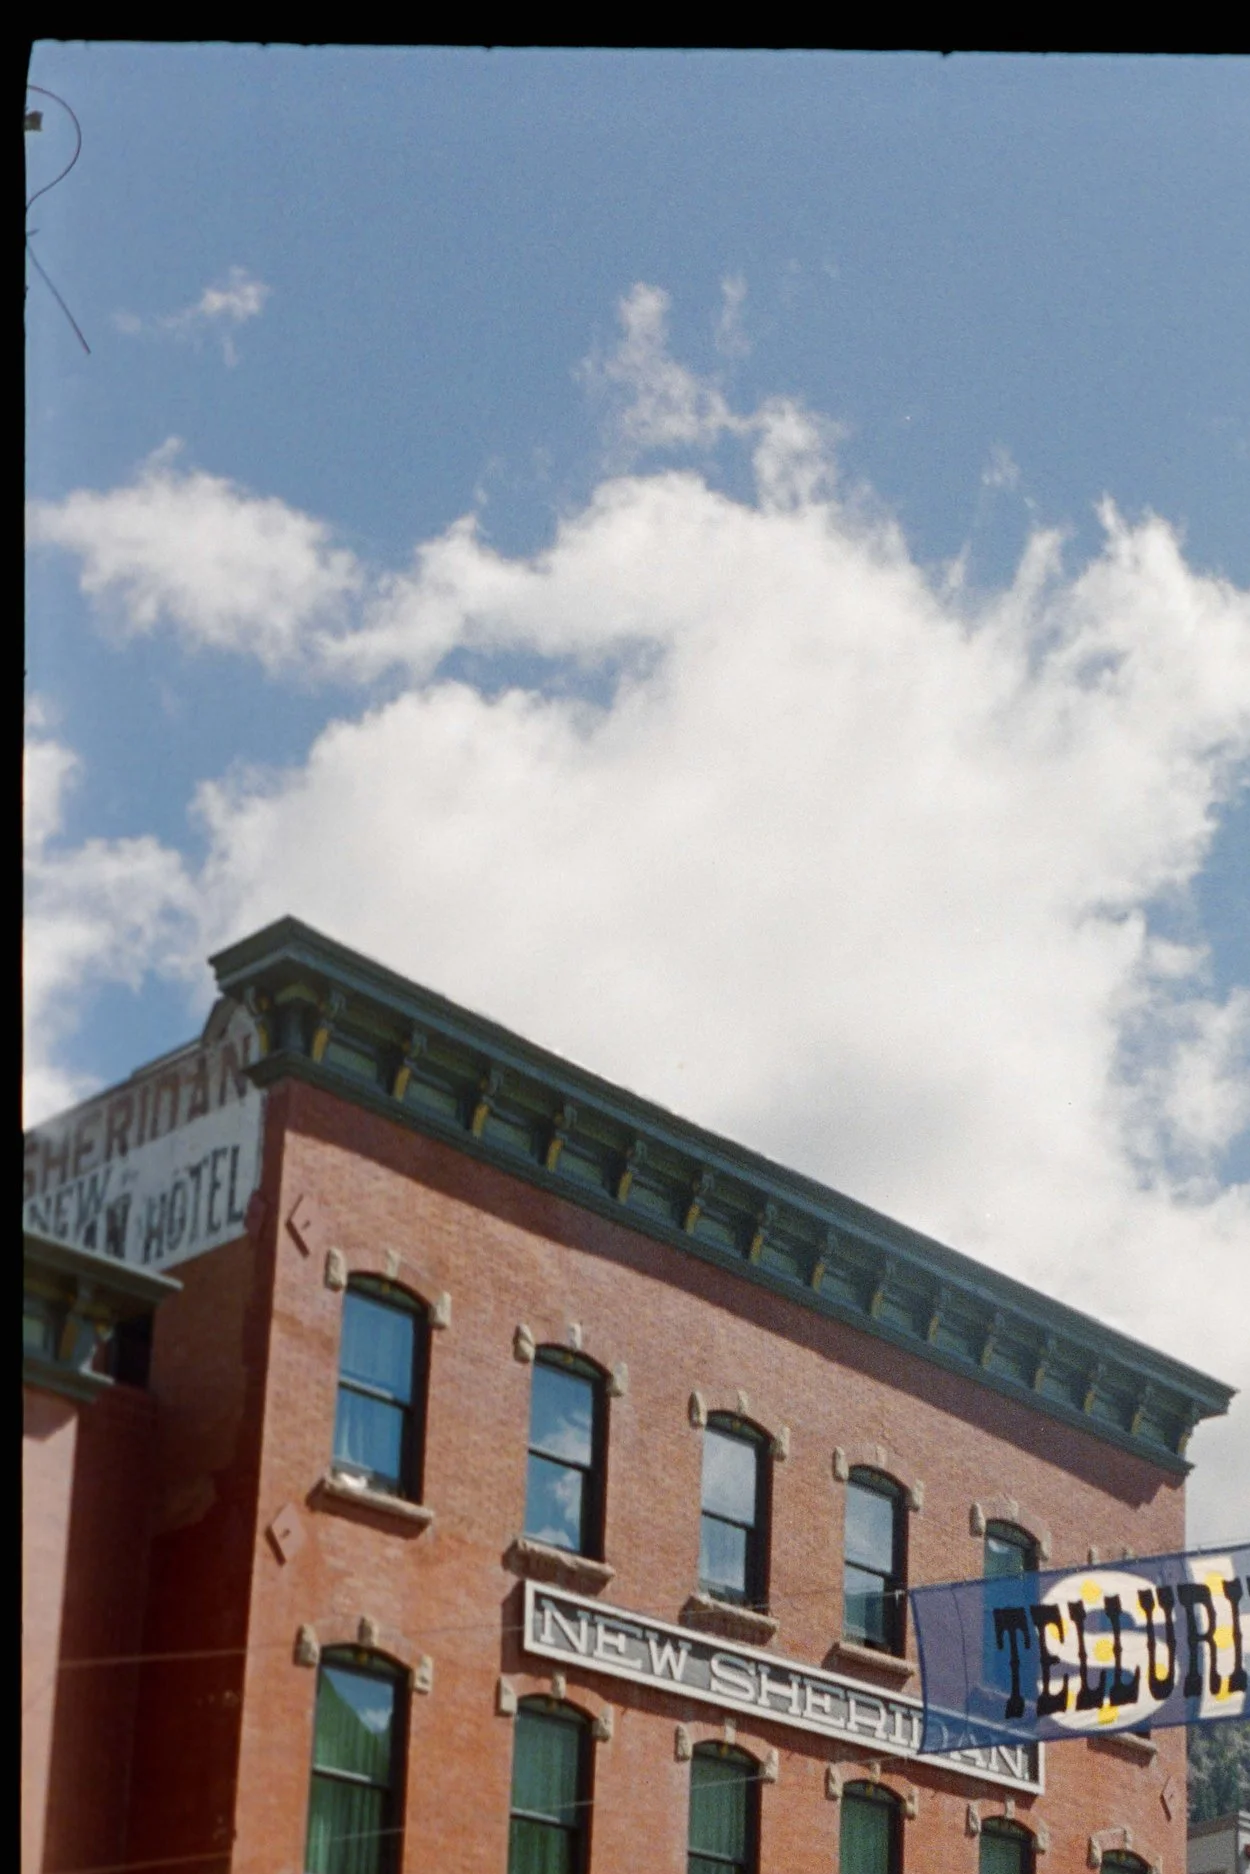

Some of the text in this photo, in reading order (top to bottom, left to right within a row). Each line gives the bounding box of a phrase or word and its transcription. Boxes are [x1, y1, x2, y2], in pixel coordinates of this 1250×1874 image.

[29, 1165, 113, 1240] NEW
[142, 1145, 245, 1263] HOTEL
[540, 1598, 692, 1682] NEW
